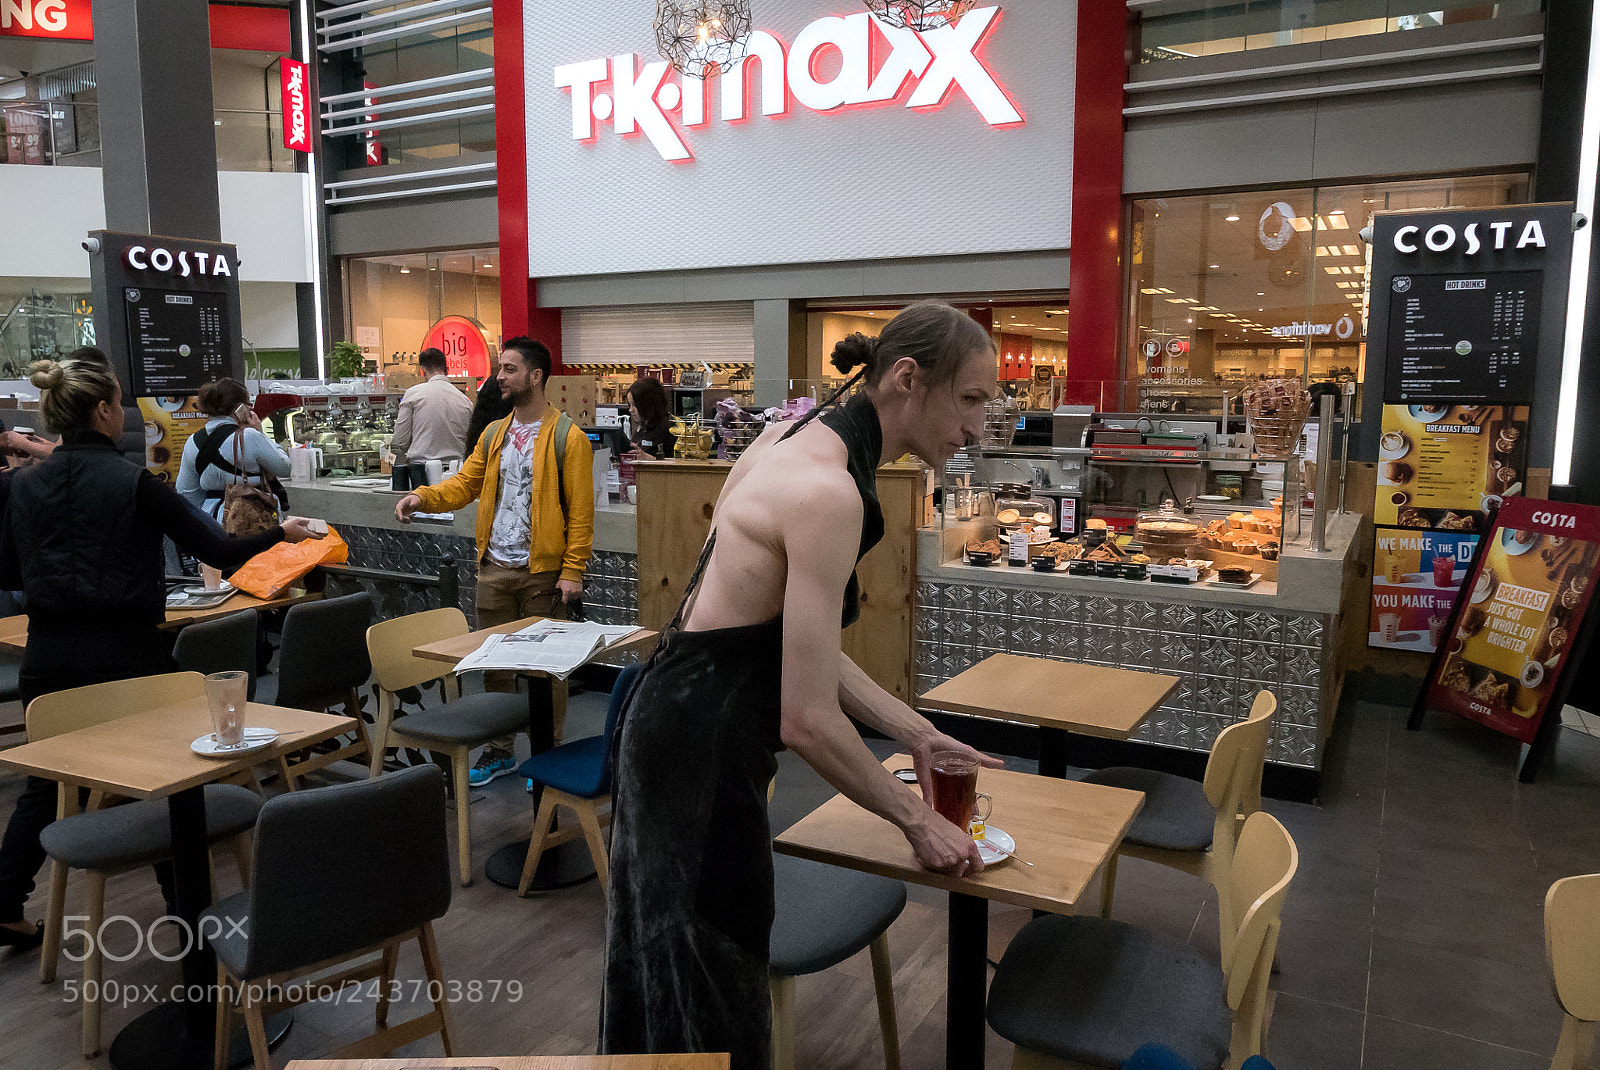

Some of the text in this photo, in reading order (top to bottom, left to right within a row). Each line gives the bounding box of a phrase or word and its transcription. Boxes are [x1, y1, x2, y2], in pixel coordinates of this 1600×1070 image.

[1393, 220, 1546, 255] COSTA
[128, 245, 231, 277] COSTA
[1447, 280, 1485, 289] HOT DRINKS
[442, 332, 467, 356] big
[1142, 366, 1185, 374] womens
[1140, 377, 1203, 386] accessories
[1140, 387, 1172, 397] shoes
[1426, 424, 1480, 434] BREAKFAST MENU
[1531, 511, 1576, 528] COSTA
[1377, 537, 1396, 551] WE
[1399, 538, 1432, 551] MAKE
[1438, 543, 1453, 553] THE
[1373, 594, 1452, 609] YOU MAKE THE
[1497, 585, 1548, 609] BREAKFAST
[1486, 602, 1524, 621] JUST GOT
[1483, 615, 1536, 640] A WHOLE LOT
[1487, 631, 1527, 653] BRIGHTER
[1469, 702, 1492, 716] COSTA
